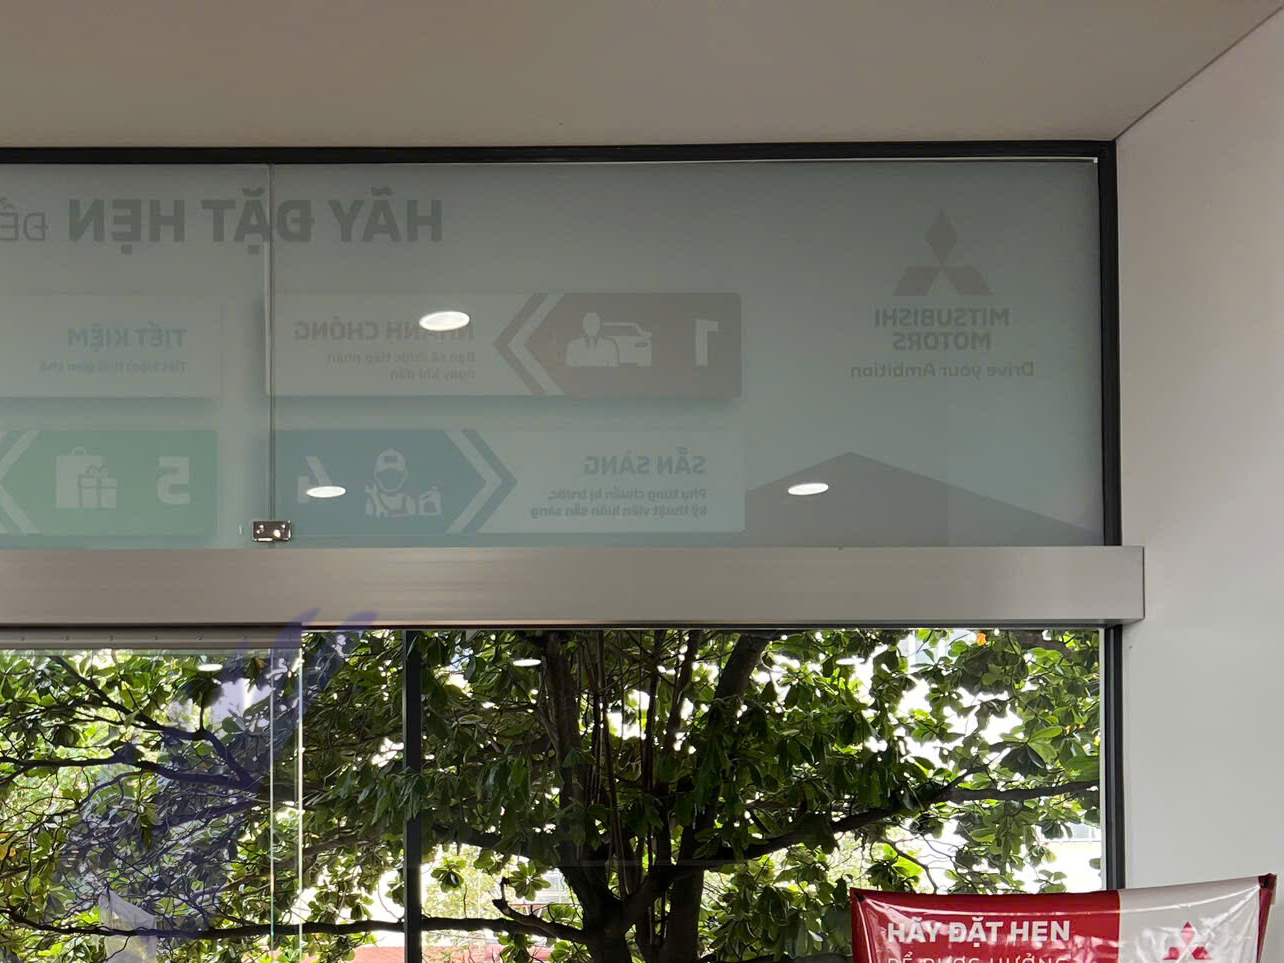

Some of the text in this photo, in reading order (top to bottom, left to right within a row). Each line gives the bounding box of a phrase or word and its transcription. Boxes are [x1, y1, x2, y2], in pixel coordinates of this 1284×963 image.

[887, 916, 1070, 949] HÃY ĐẶT HẸN
